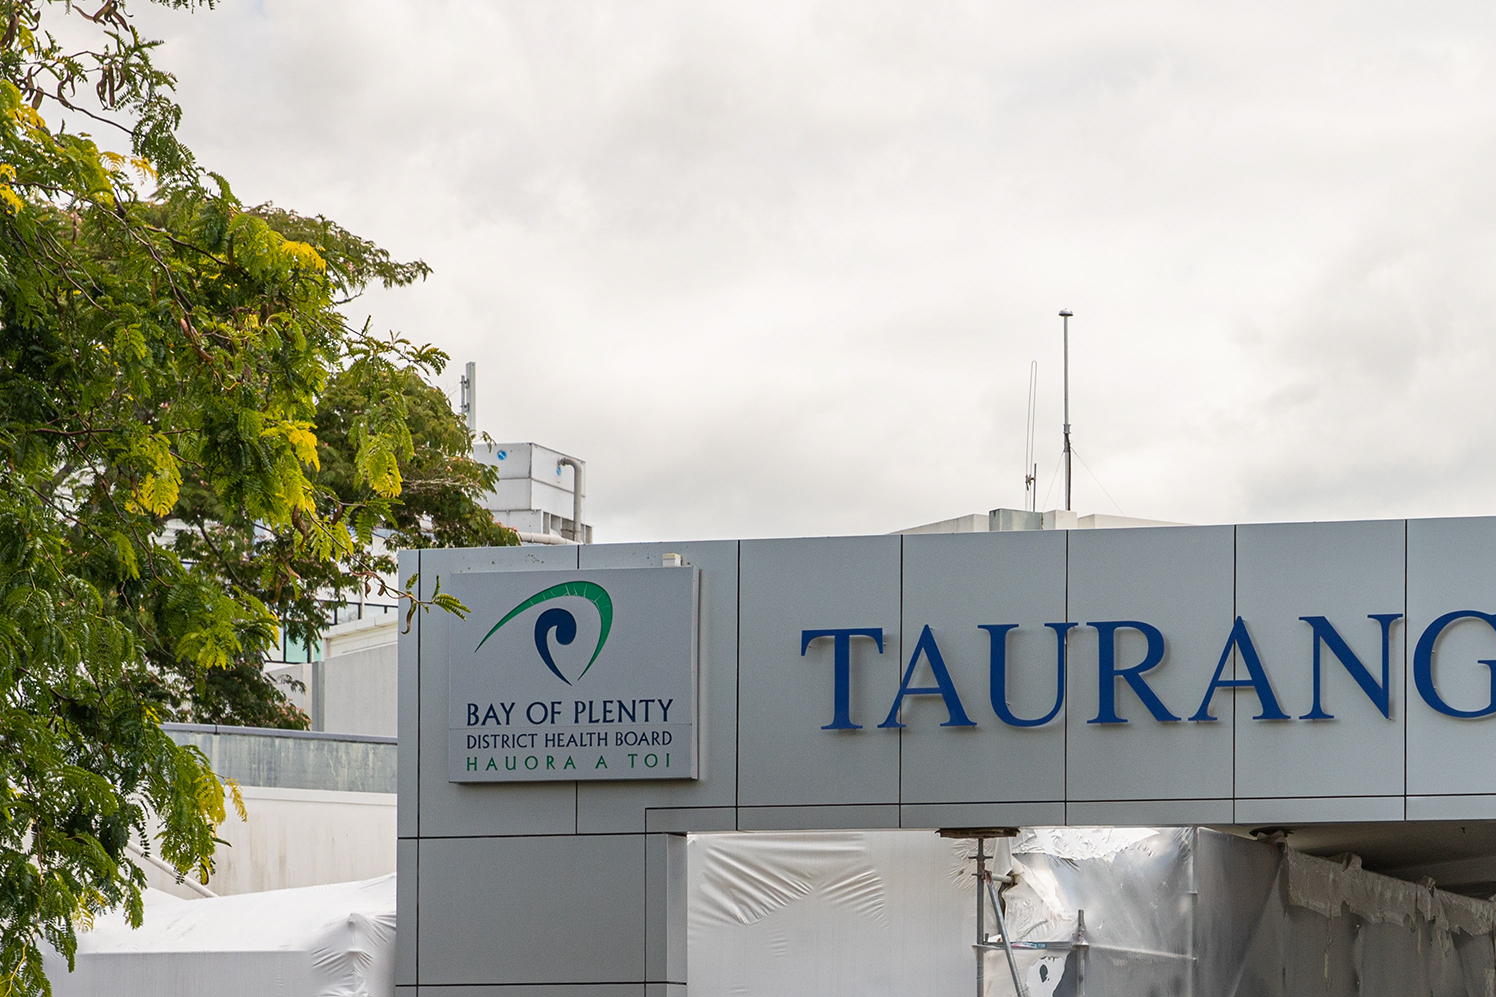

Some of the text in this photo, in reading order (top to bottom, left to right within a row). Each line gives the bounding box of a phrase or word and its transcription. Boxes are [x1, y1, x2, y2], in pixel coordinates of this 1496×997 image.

[467, 698, 674, 727] BAY OF PLENTY
[467, 731, 673, 749] DISTRICT HEALTH BOARD
[467, 753, 670, 771] HAUORA A TOI
